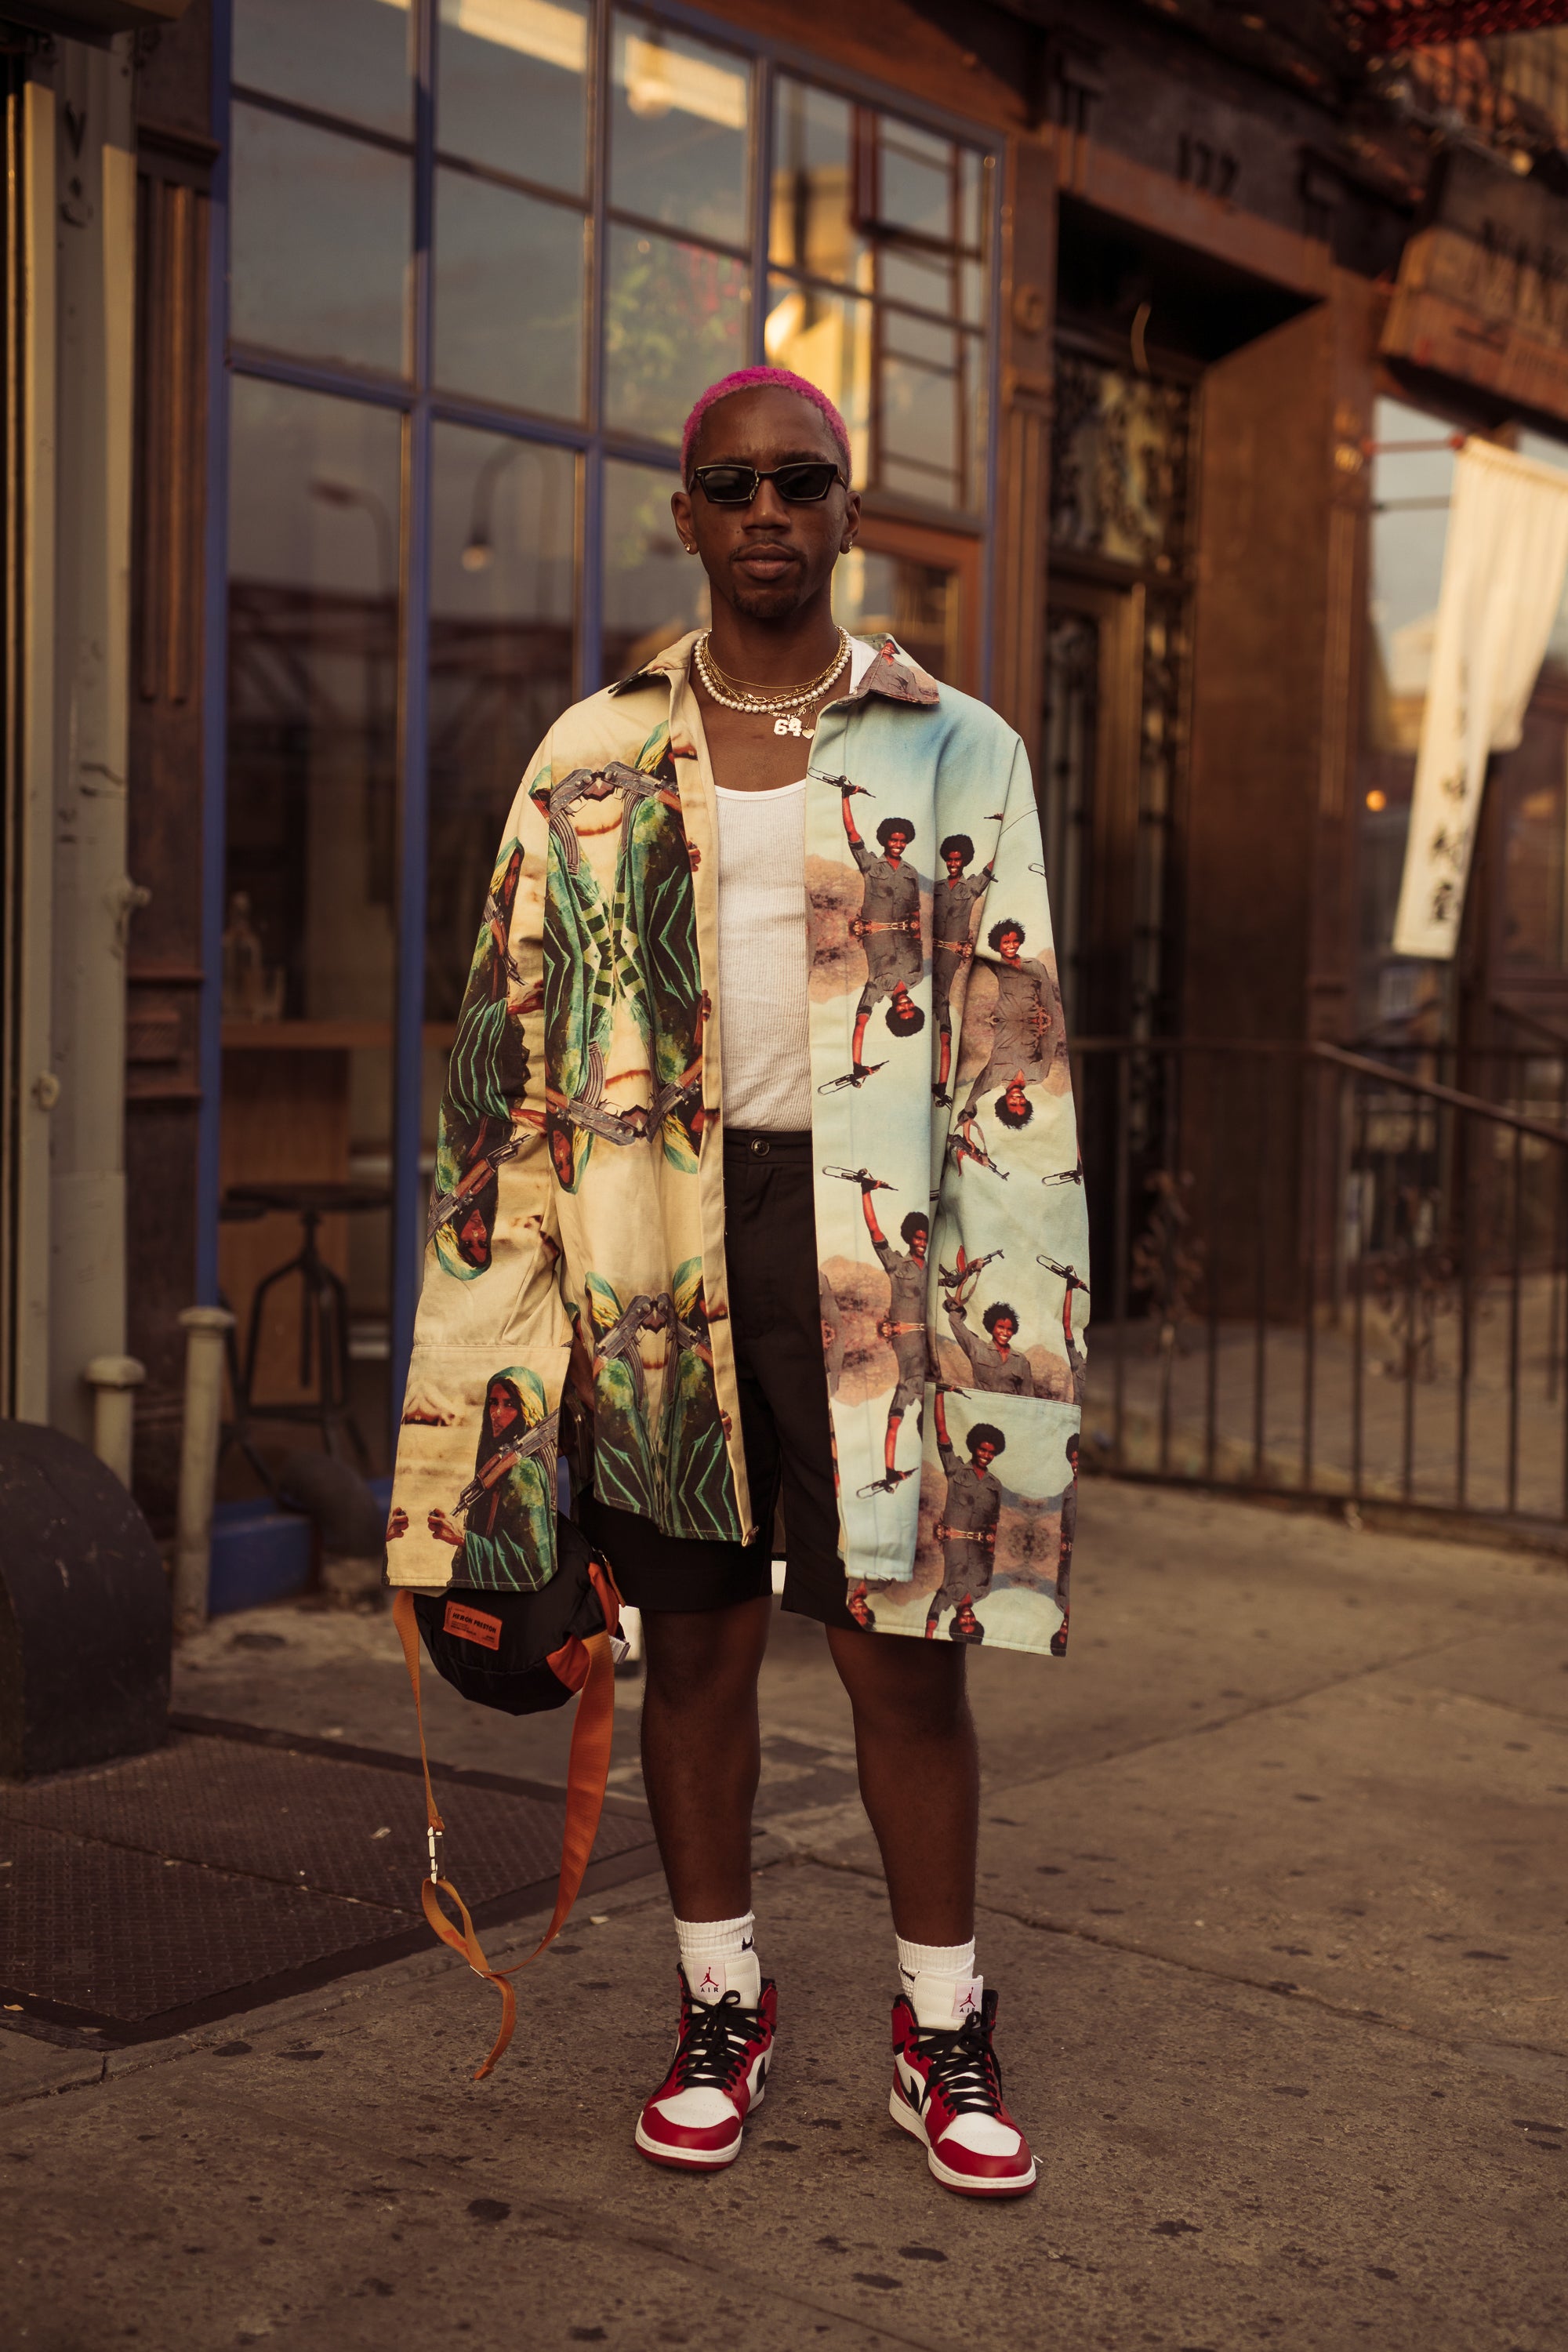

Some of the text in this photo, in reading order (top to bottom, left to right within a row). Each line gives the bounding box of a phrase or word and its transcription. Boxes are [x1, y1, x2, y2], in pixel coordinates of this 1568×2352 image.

[773, 717, 802, 737] 64
[452, 1612, 473, 1624] HERON
[474, 1620, 496, 1634] PRESTON
